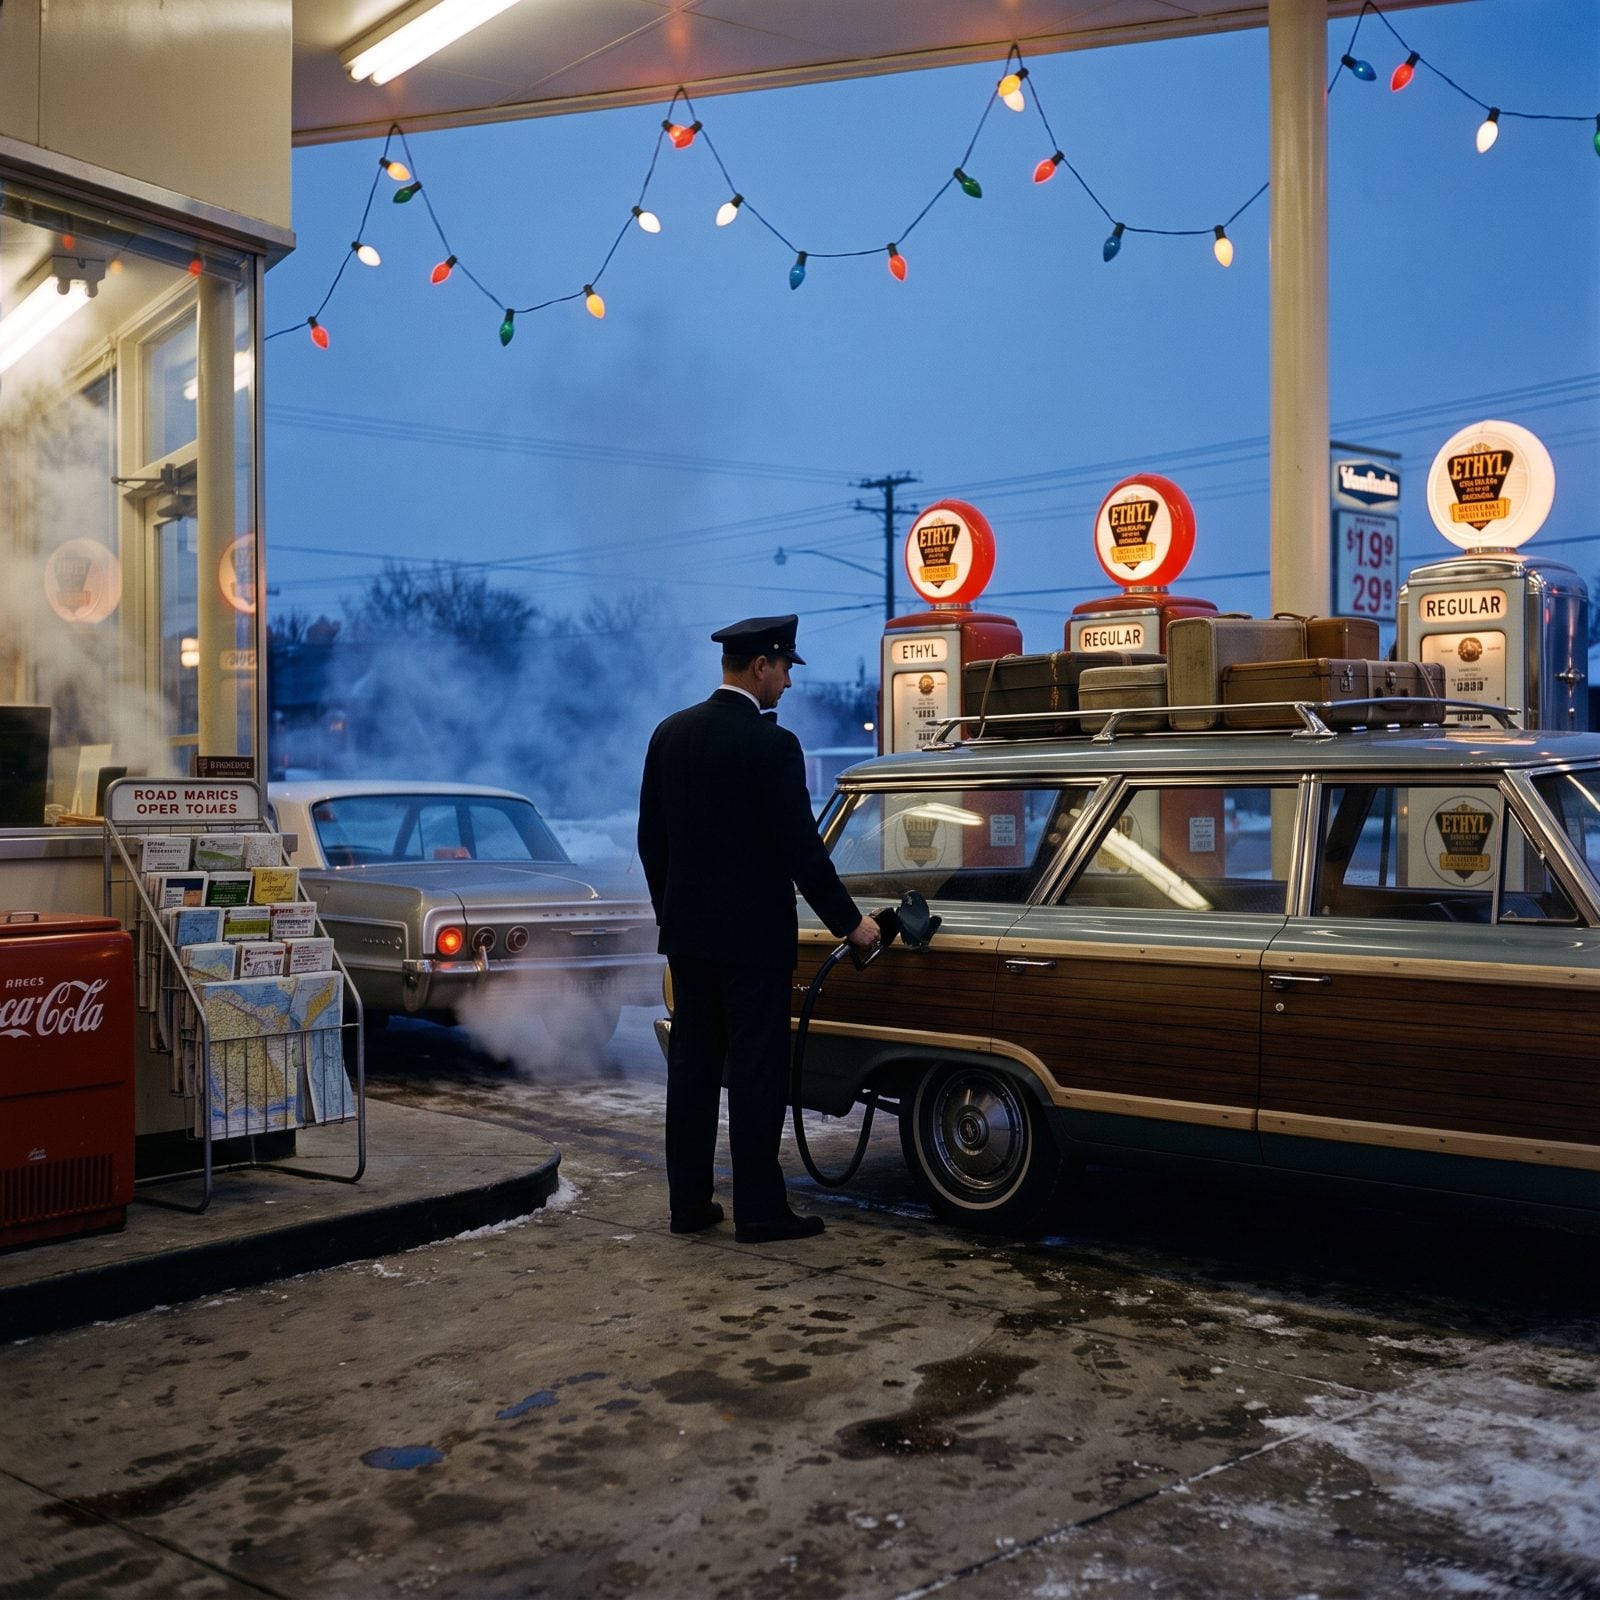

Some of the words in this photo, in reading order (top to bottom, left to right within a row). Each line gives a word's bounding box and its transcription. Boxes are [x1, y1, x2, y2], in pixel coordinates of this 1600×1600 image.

[1451, 454, 1507, 481] ETHYL
[1111, 502, 1153, 526] ETHYL
[919, 526, 956, 548] ETHYL
[1426, 595, 1501, 617] REGULAR
[1083, 628, 1141, 648] REGULAR
[902, 643, 938, 659] ETHYL
[134, 790, 177, 800] ROAD
[184, 790, 239, 800] MARICS
[136, 804, 180, 814] OPER
[1441, 814, 1488, 833] ETHYL
